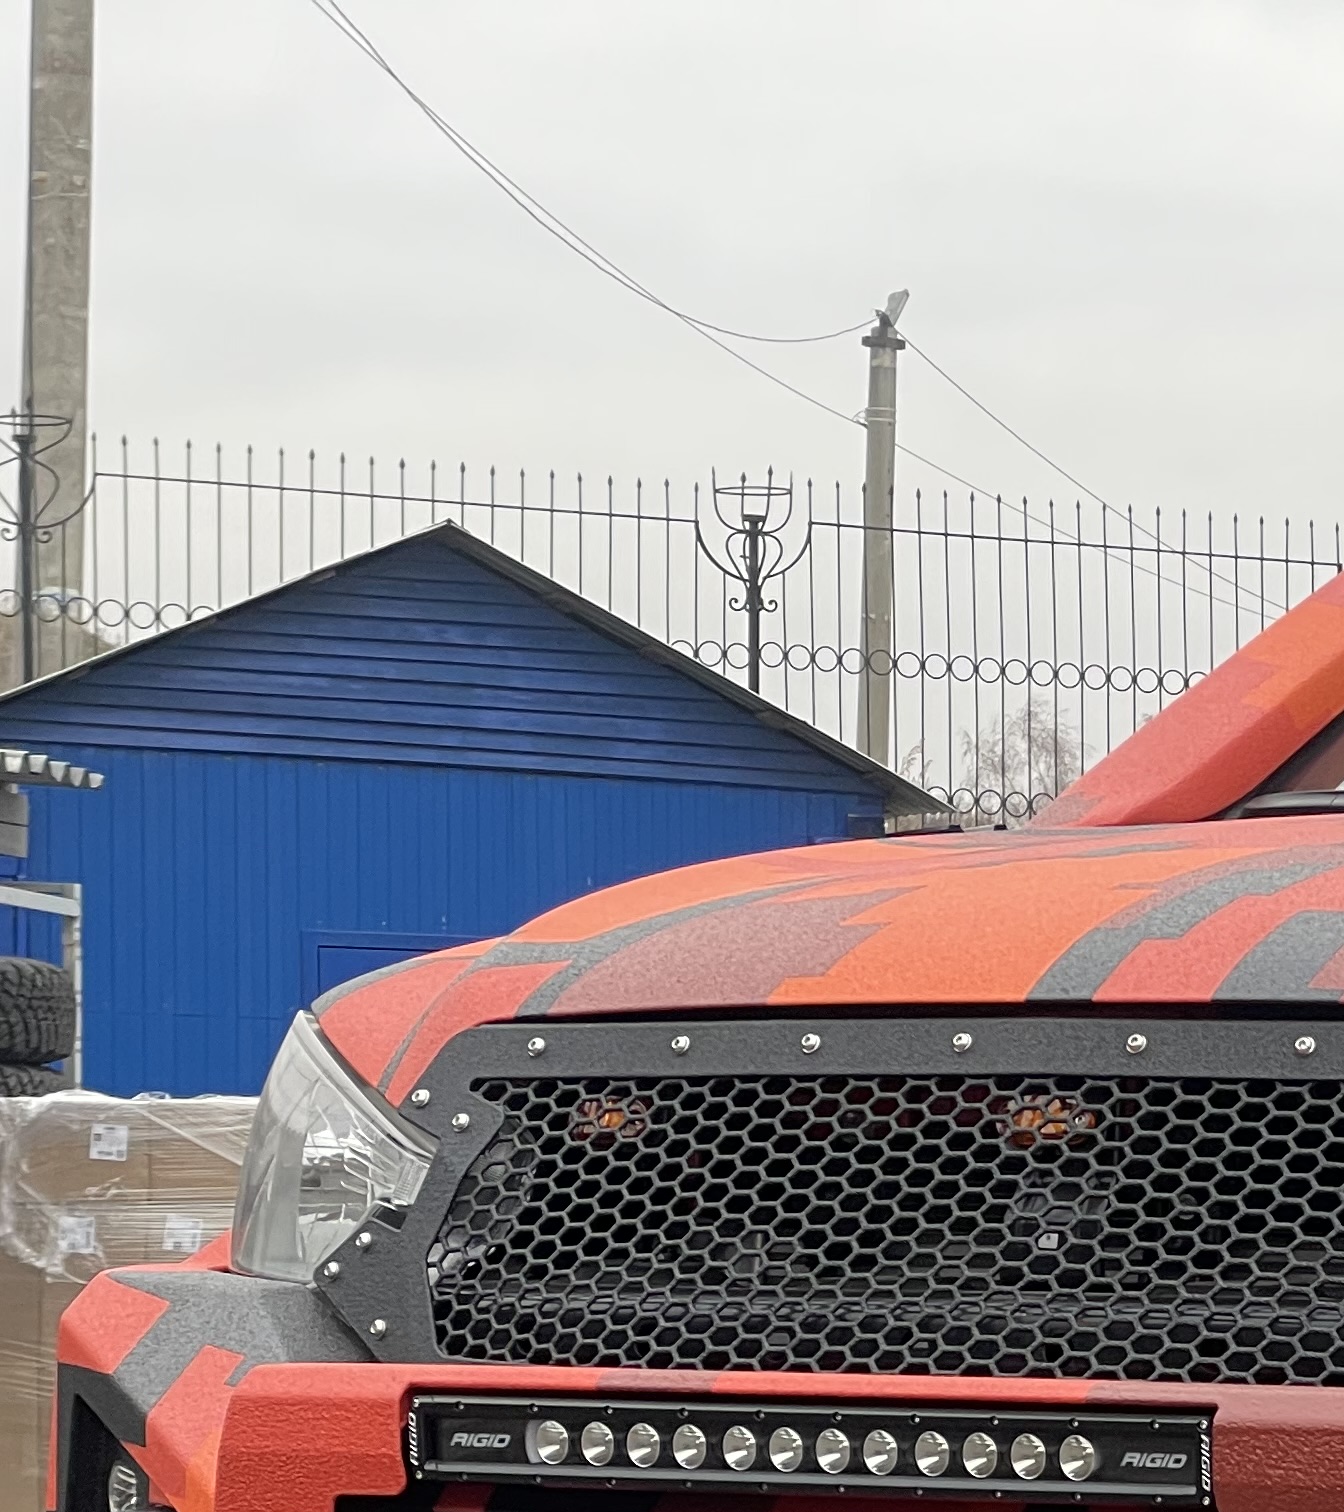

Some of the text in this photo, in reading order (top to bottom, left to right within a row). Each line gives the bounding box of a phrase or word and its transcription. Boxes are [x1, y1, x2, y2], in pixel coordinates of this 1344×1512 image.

[408, 1411, 419, 1466] RIGID
[450, 1432, 512, 1449] RIGID
[1120, 1451, 1188, 1469] RIGID
[1200, 1433, 1211, 1492] RIGID
